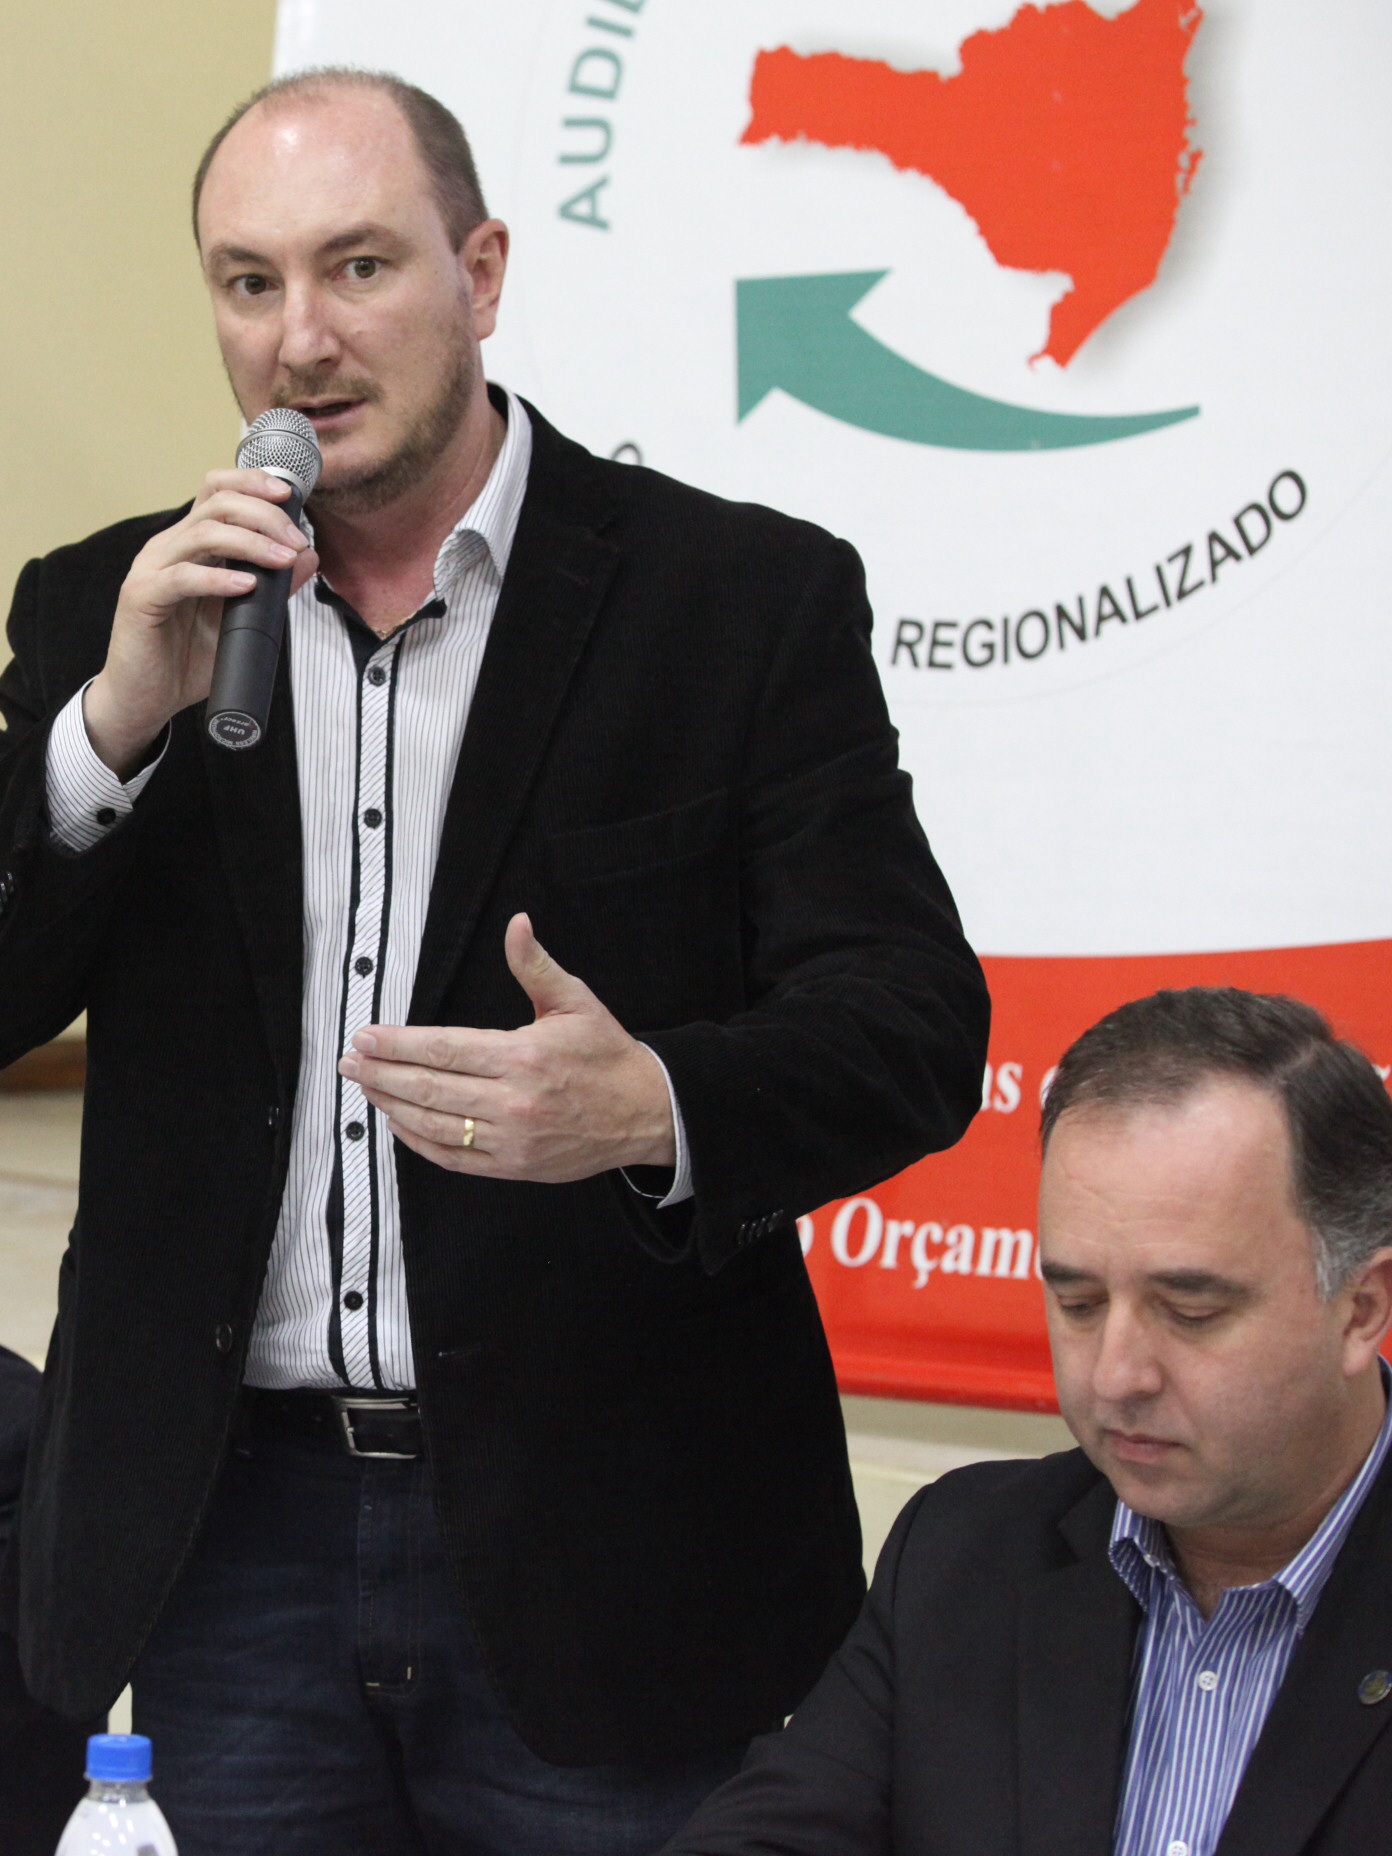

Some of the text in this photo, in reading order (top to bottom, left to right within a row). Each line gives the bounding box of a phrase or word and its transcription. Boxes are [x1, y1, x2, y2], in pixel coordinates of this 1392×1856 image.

[891, 469, 1307, 669] REGIONALIZADO
[223, 725, 245, 735] UHF
[830, 1197, 1042, 1289] Orçam
